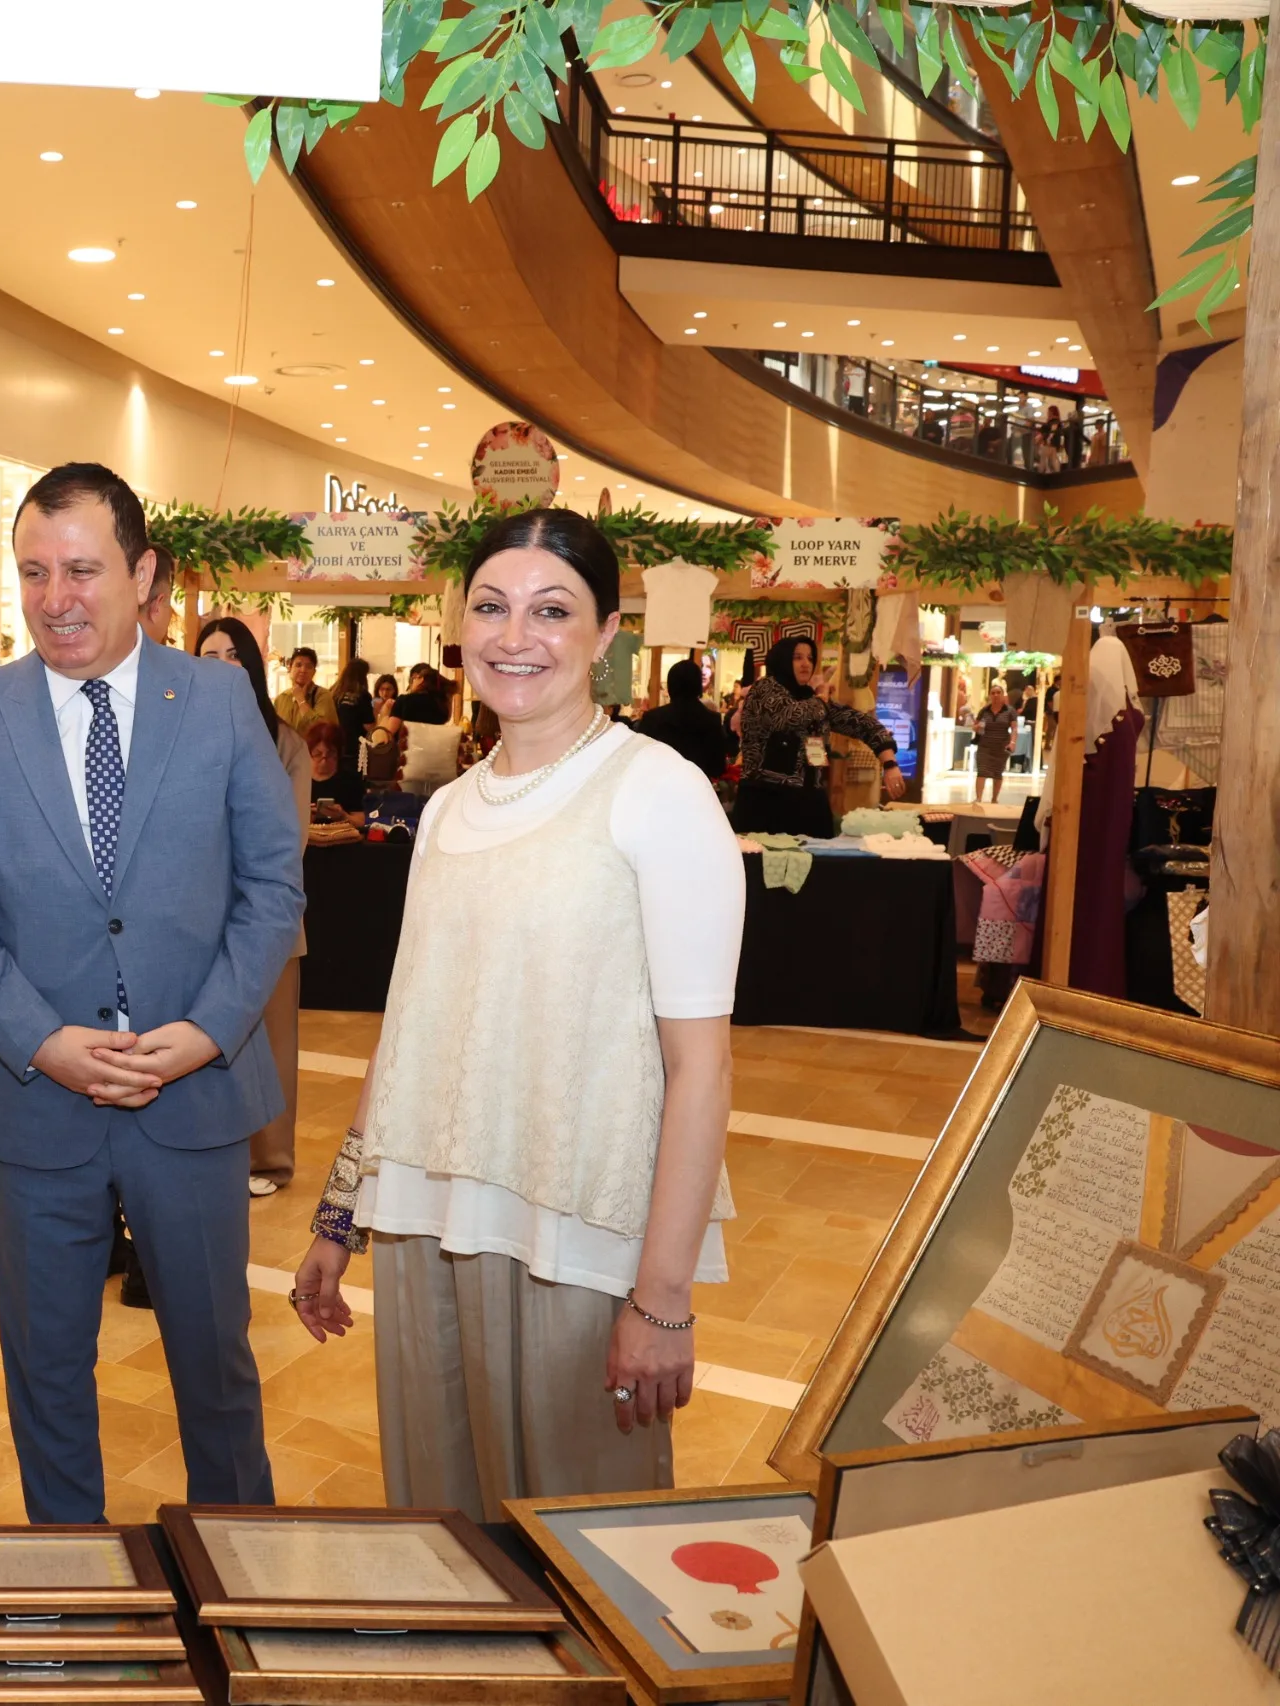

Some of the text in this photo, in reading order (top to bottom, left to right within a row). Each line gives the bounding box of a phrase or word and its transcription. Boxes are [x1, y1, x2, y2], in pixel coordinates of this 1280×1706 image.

[516, 467, 538, 475] EMEĞİ
[317, 526, 400, 539] KARYA ÇANTA
[349, 541, 366, 552] VE
[790, 540, 862, 551] LOOP YARN
[313, 553, 403, 567] HOBİ ATÖLYESİ
[793, 556, 858, 566] BY MERVE
